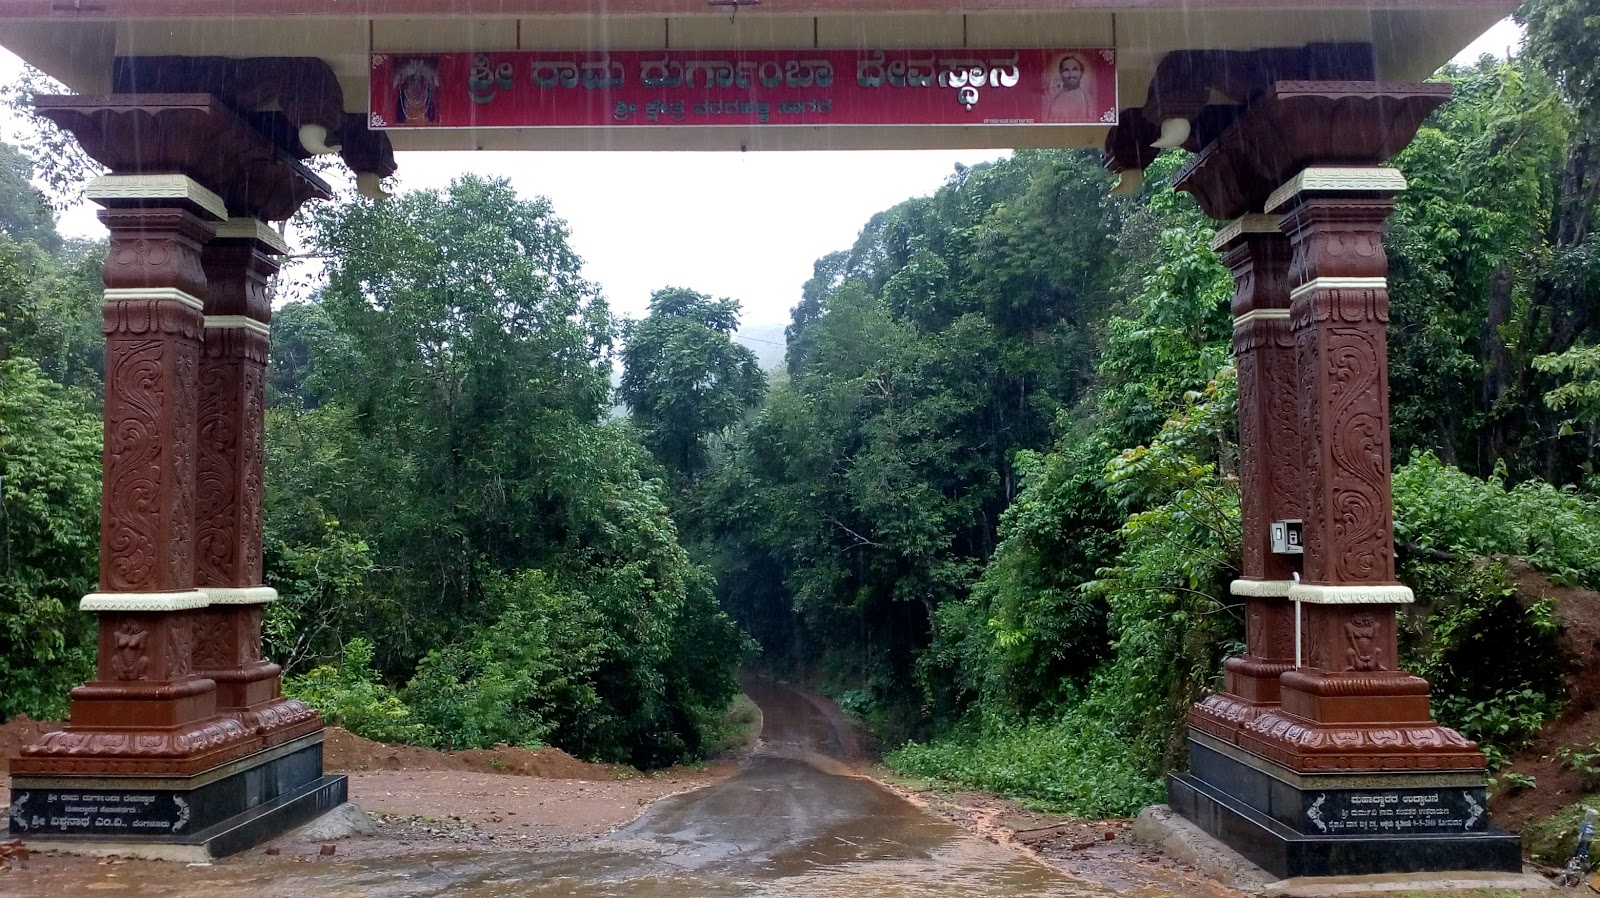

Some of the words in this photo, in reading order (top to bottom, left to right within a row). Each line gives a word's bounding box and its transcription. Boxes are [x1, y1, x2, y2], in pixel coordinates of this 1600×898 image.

[468, 51, 514, 104] ಶ್ರೀ
[531, 50, 625, 89] ರಾಮ
[857, 49, 1020, 111] ದೇವಸ್ಥಾನ
[31, 814, 46, 829] ಶ್ರೀ
[50, 816, 90, 831] ವಿಶ್ವನಾಥ
